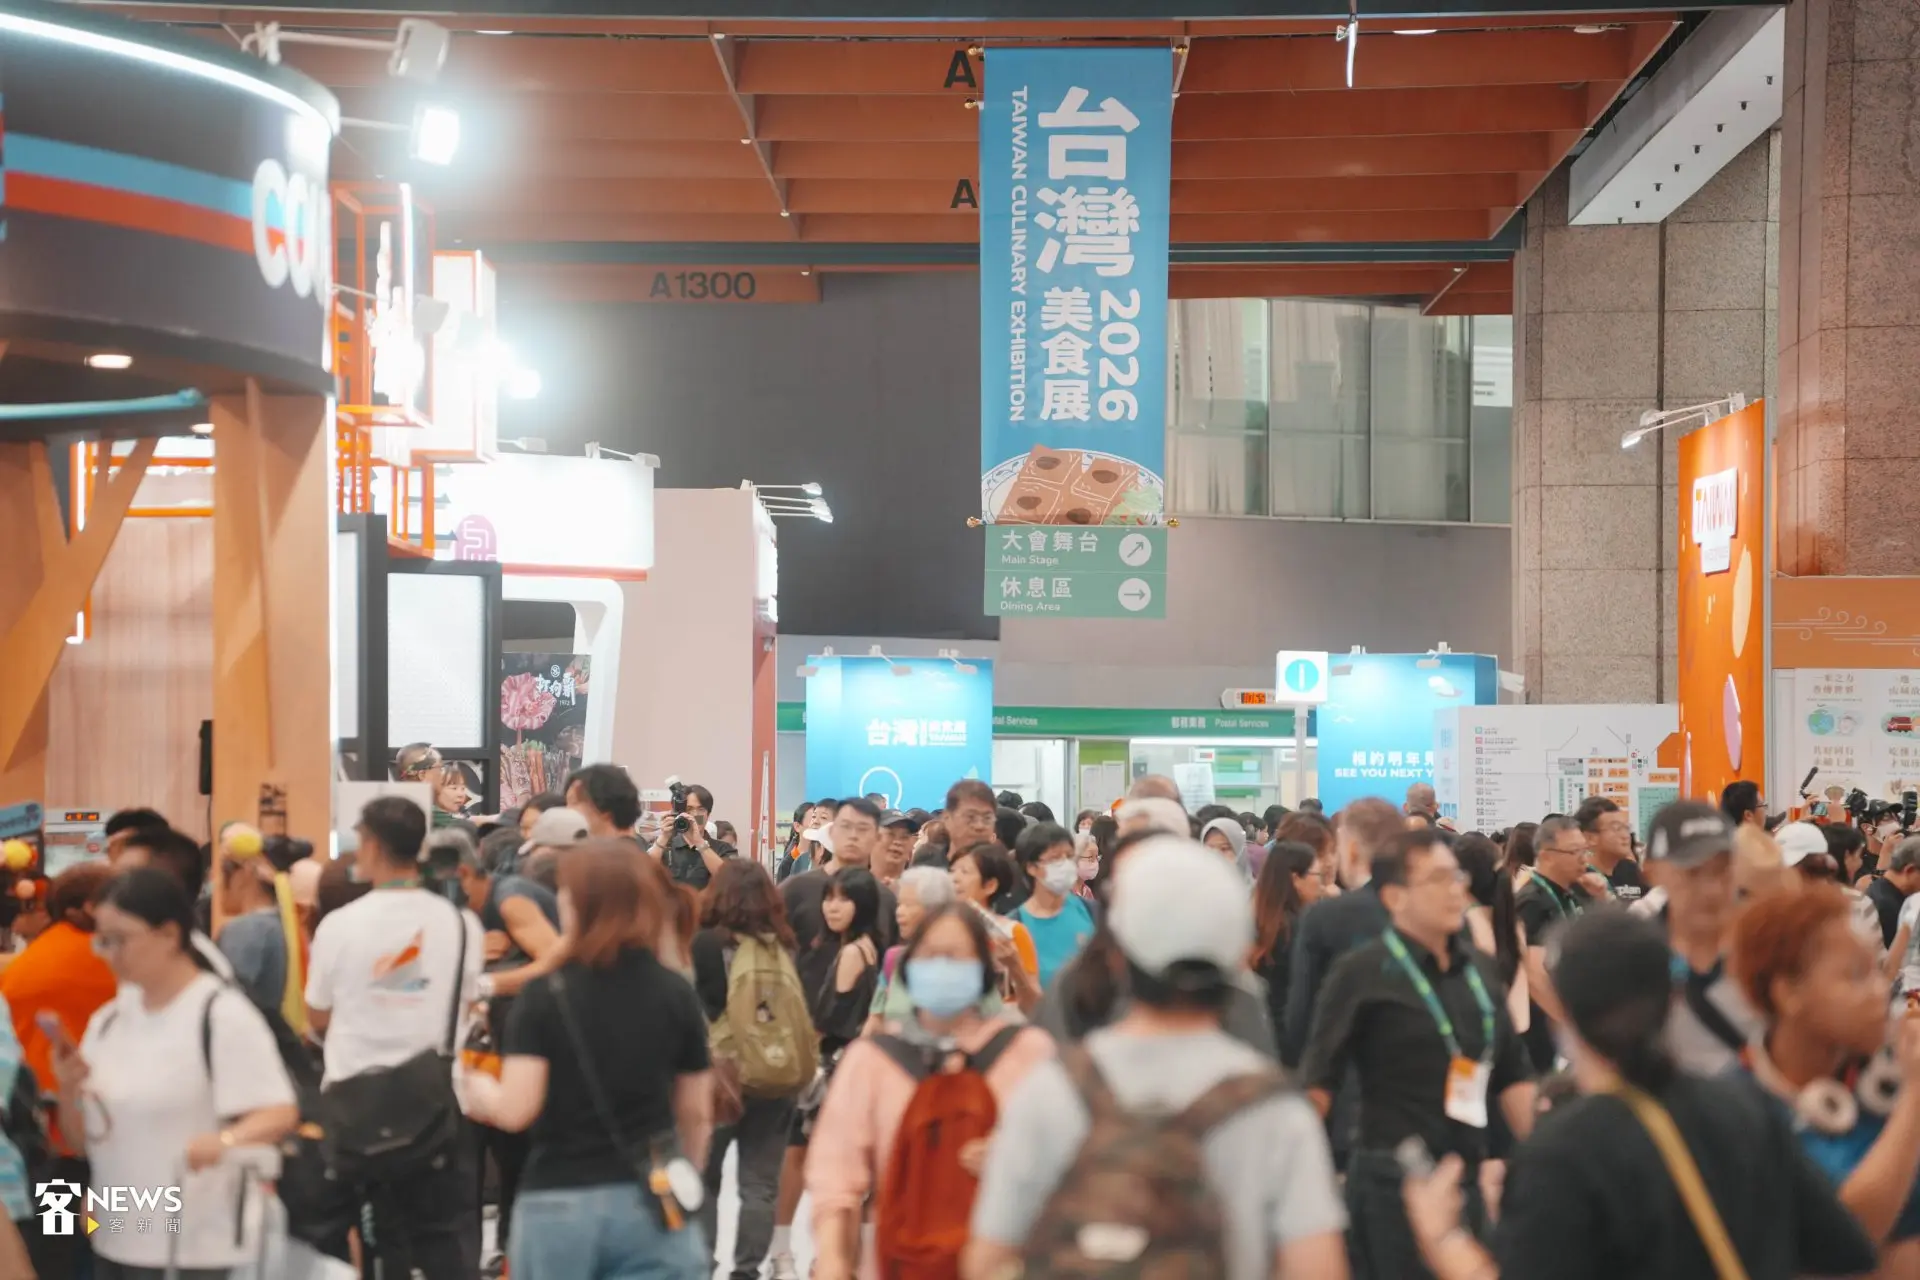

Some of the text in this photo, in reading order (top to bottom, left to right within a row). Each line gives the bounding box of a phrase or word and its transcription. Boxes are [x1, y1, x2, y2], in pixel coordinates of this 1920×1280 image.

[943, 50, 984, 89] A
[950, 178, 980, 209] A
[1034, 86, 1140, 277] 台灣
[1010, 85, 1028, 421] TAIWAN CULINARY EXHIBITION
[649, 271, 756, 299] A1300
[1040, 286, 1093, 421] 美食展
[1098, 288, 1141, 421] 2026
[1002, 530, 1098, 552] 大會舞台
[1001, 555, 1059, 566] Main Stage
[1000, 576, 1072, 598] 休息區
[1000, 602, 1061, 612] Dining Area
[1334, 768, 1358, 778] SEE
[1360, 768, 1387, 778] YOU
[1390, 768, 1423, 778] NEXT
